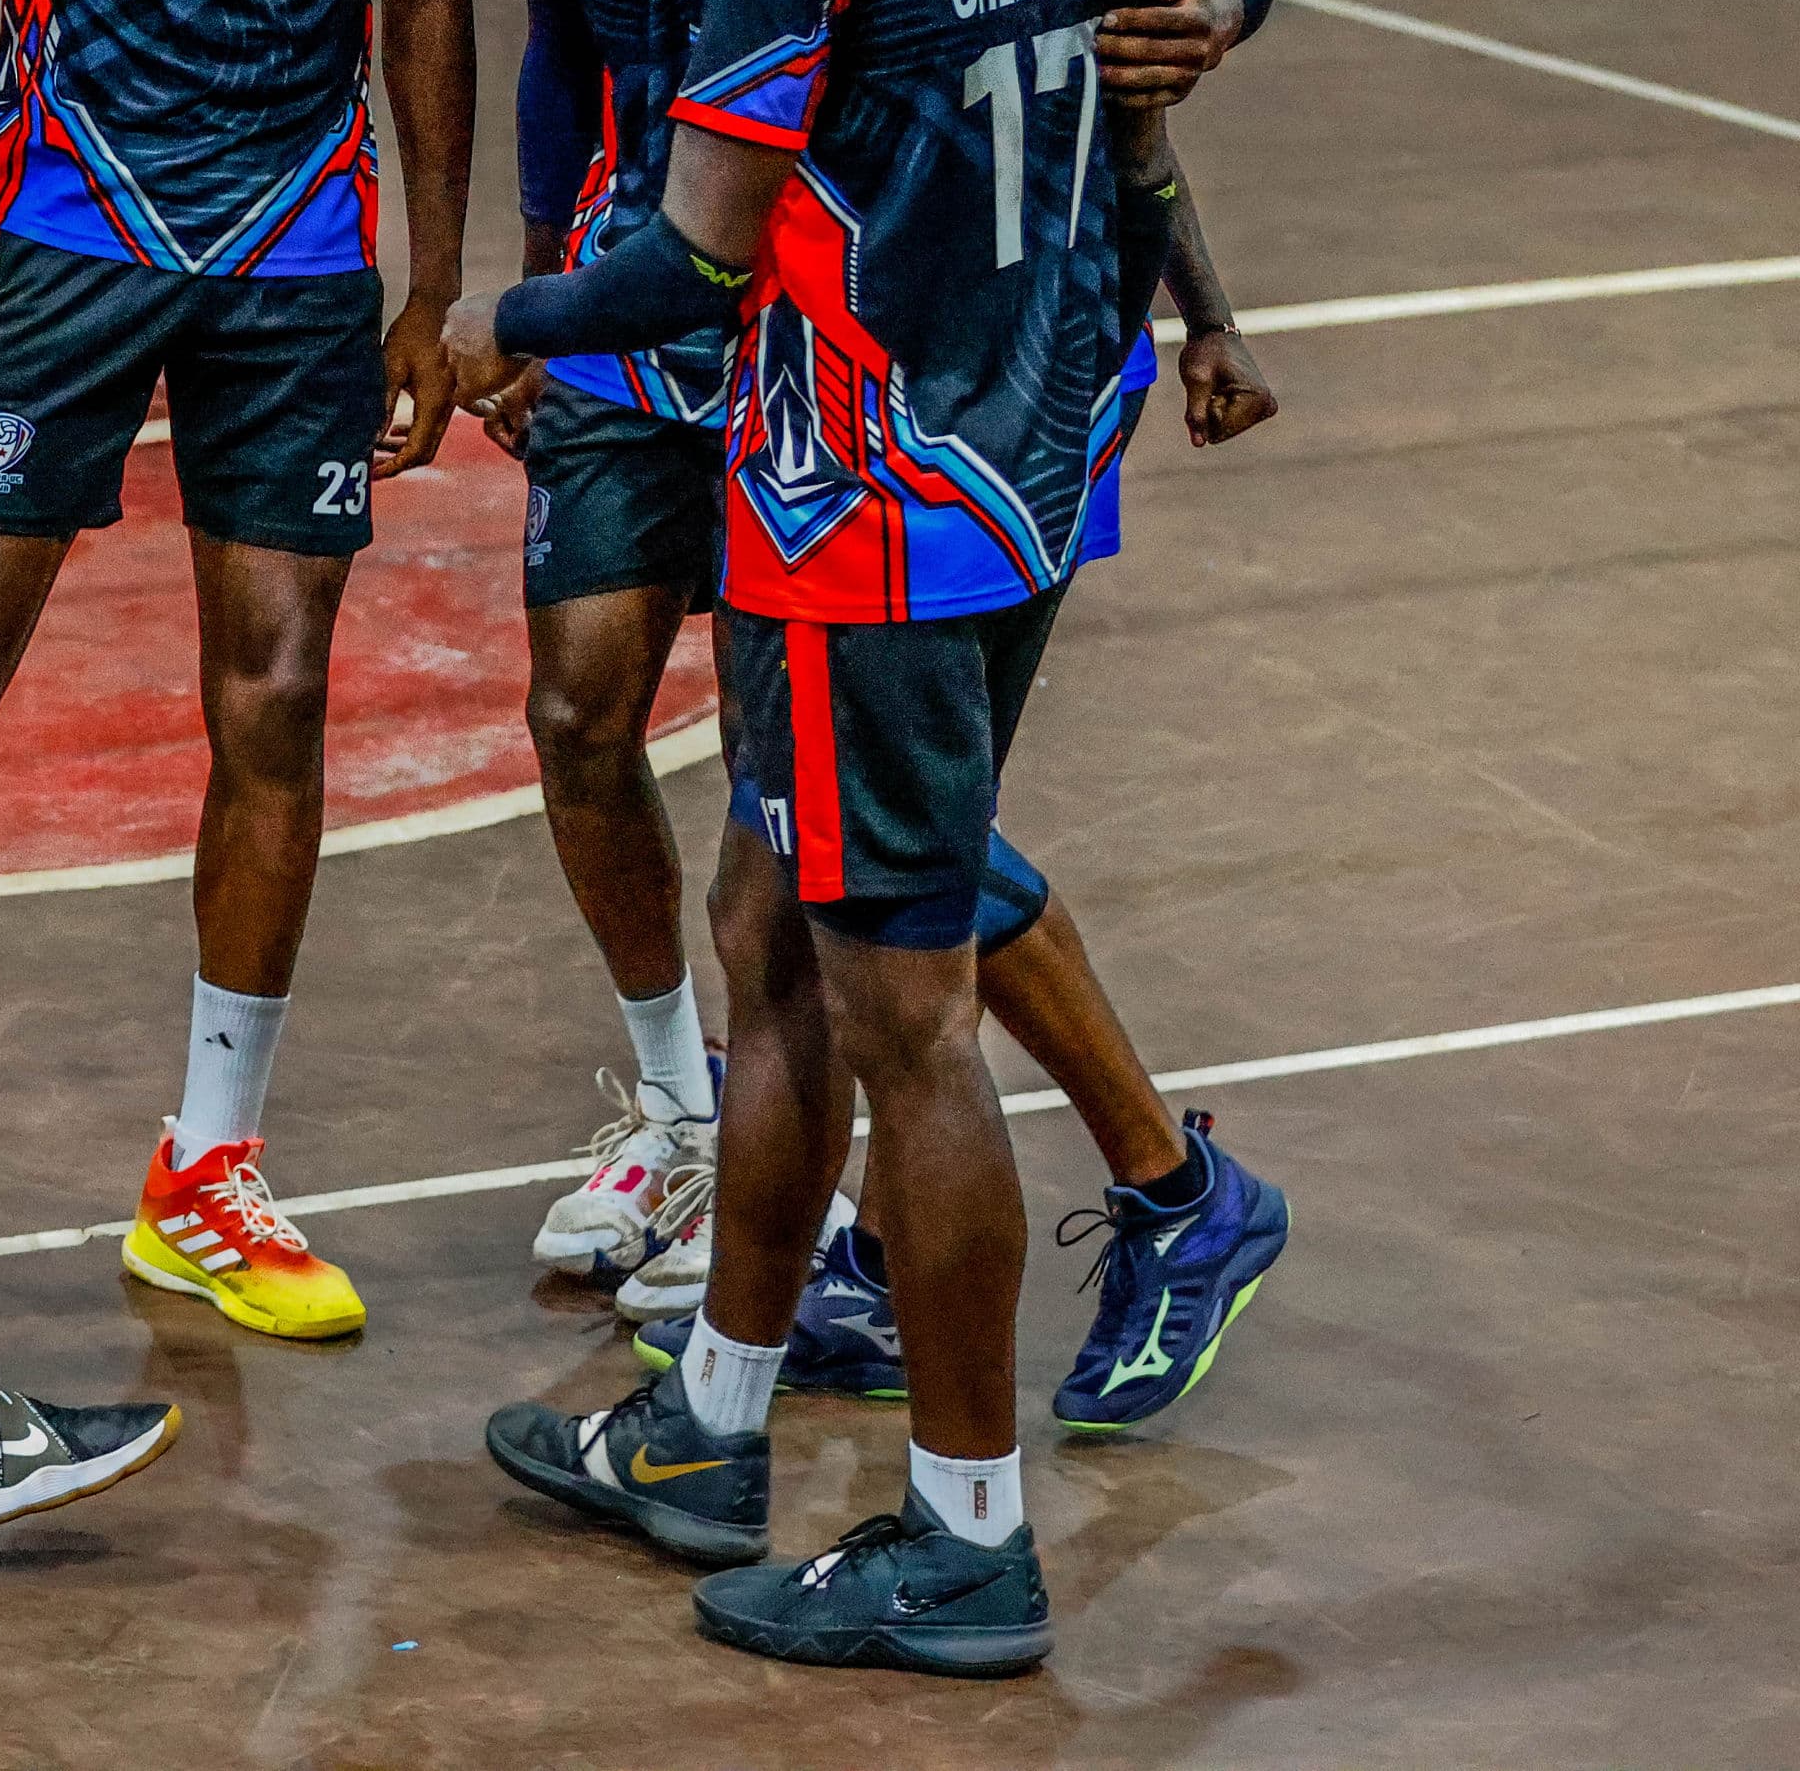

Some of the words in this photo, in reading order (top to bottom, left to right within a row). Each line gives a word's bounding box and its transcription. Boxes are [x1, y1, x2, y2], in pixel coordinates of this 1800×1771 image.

[963, 16, 1102, 270] 17
[312, 460, 368, 515] 23
[759, 796, 792, 855] 17
